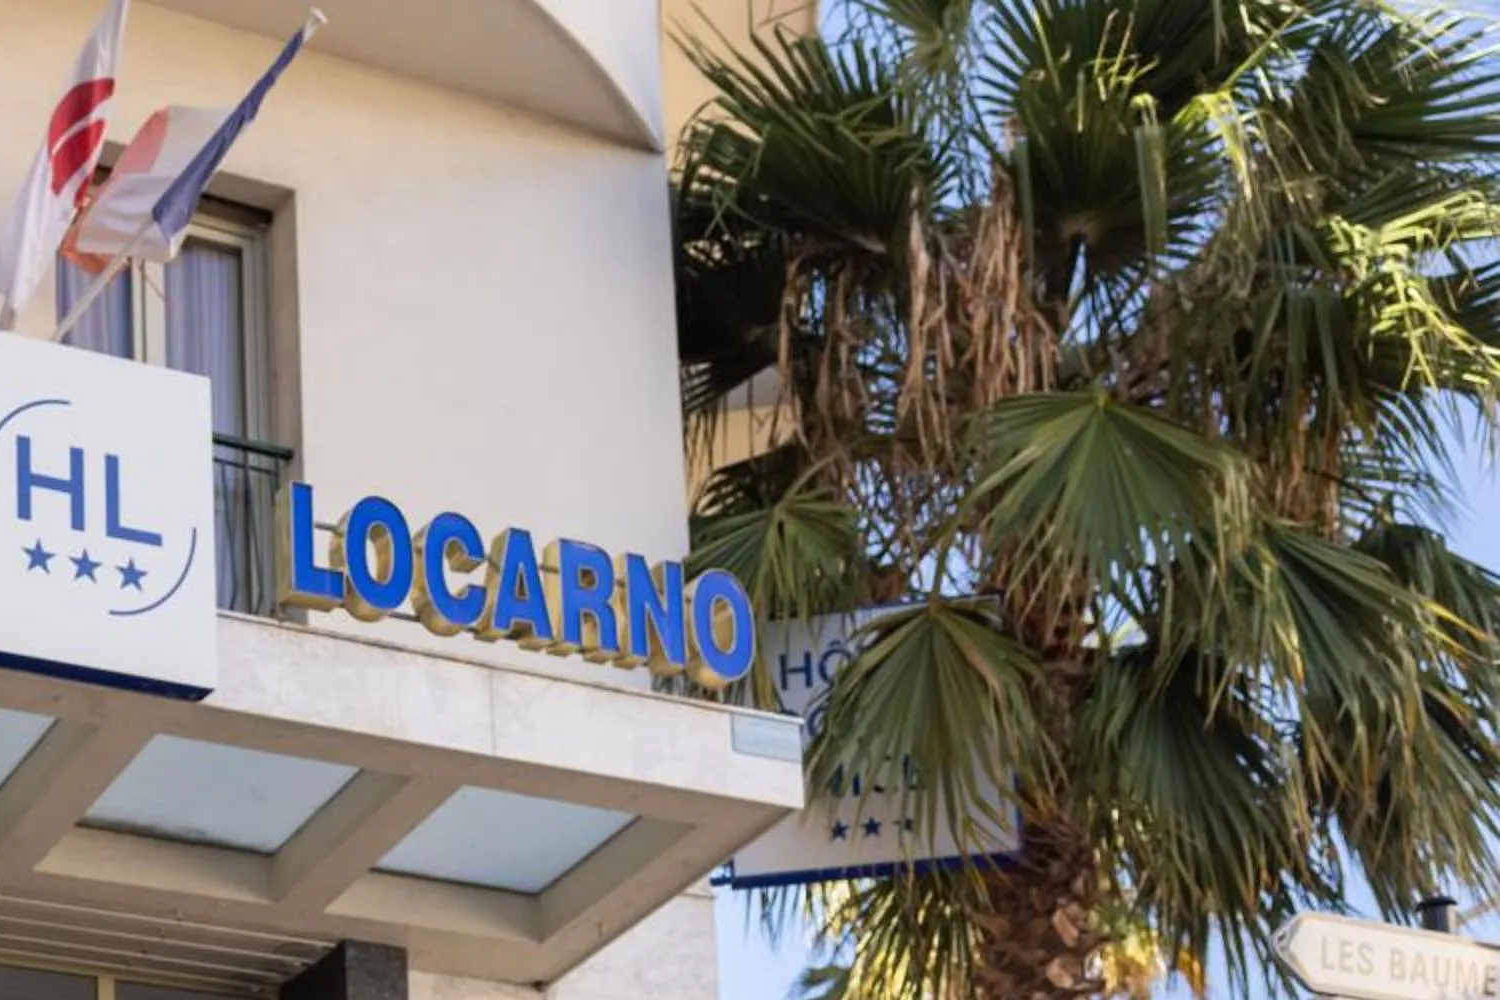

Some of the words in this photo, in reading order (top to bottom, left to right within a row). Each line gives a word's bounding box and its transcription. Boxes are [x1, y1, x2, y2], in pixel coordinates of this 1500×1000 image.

[15, 434, 164, 548] HL
[287, 480, 756, 684] LOCARNO
[1320, 935, 1375, 977] LES
